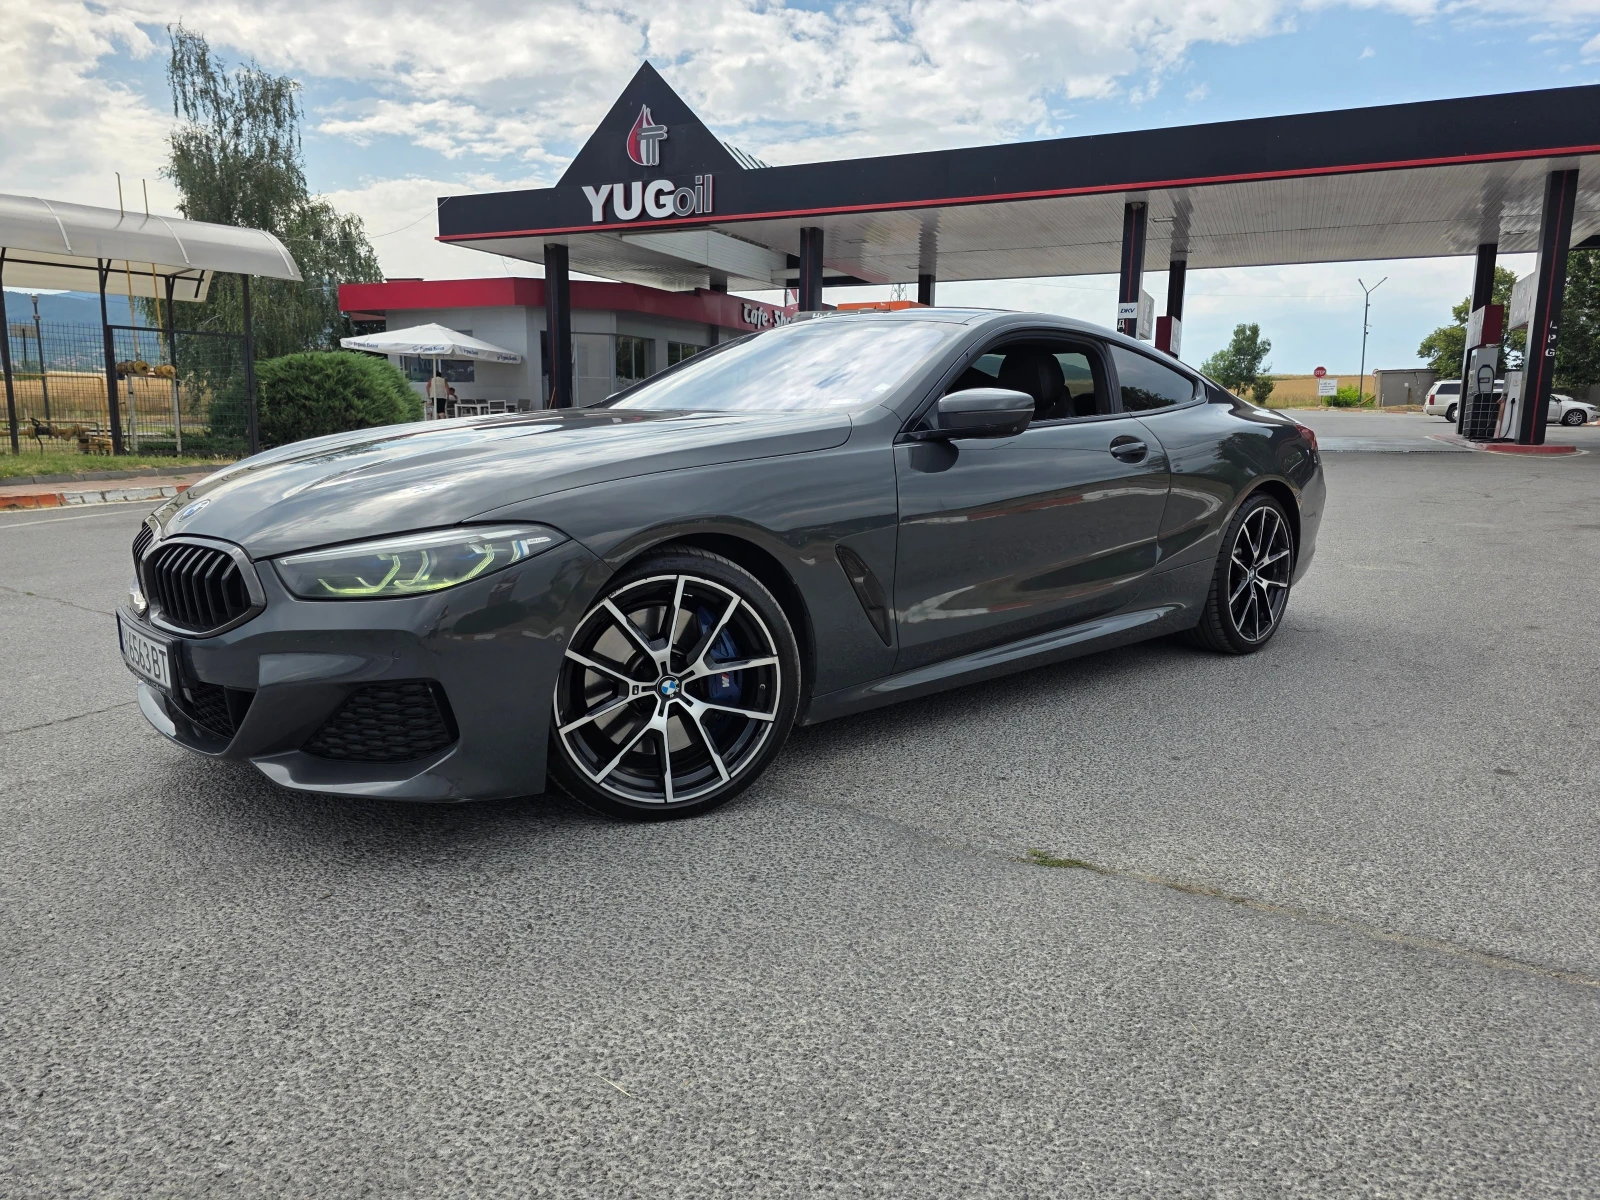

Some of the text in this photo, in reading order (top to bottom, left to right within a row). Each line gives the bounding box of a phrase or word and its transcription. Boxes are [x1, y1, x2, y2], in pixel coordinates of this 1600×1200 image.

[581, 174, 713, 222] YUGoil
[743, 303, 792, 329] Cafe Sho
